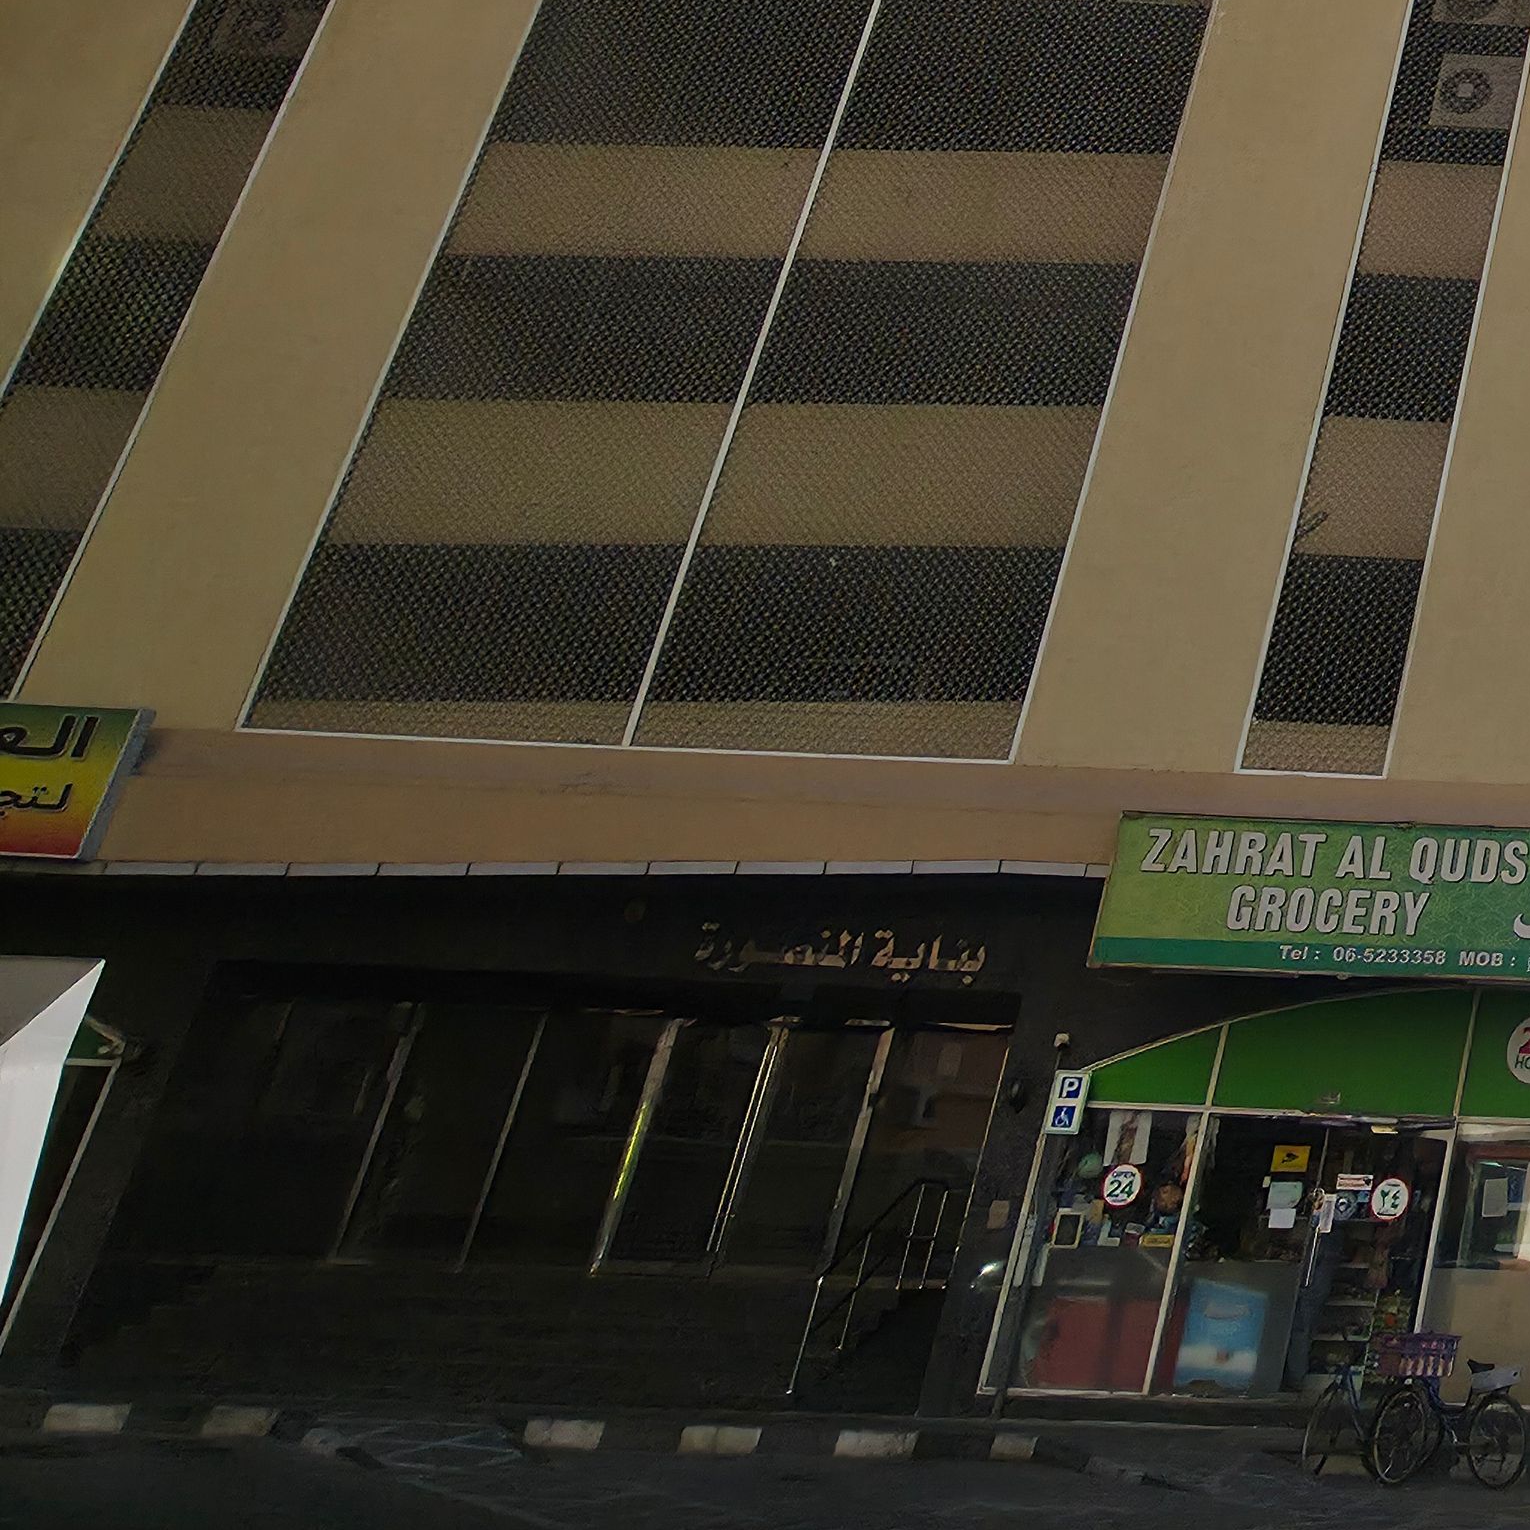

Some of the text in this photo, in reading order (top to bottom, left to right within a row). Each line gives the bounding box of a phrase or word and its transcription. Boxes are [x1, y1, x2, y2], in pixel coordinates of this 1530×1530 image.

[1139, 827, 1530, 885] ZAHRAT AL QUDS
[1226, 885, 1431, 937] GROCERY
[870, 928, 987, 986] بناية
[1279, 944, 1309, 961] Tel
[1332, 946, 1447, 967] 06-5233358
[1458, 950, 1505, 967] MOB
[1060, 1077, 1080, 1099] P
[1106, 1179, 1135, 1199] 24
